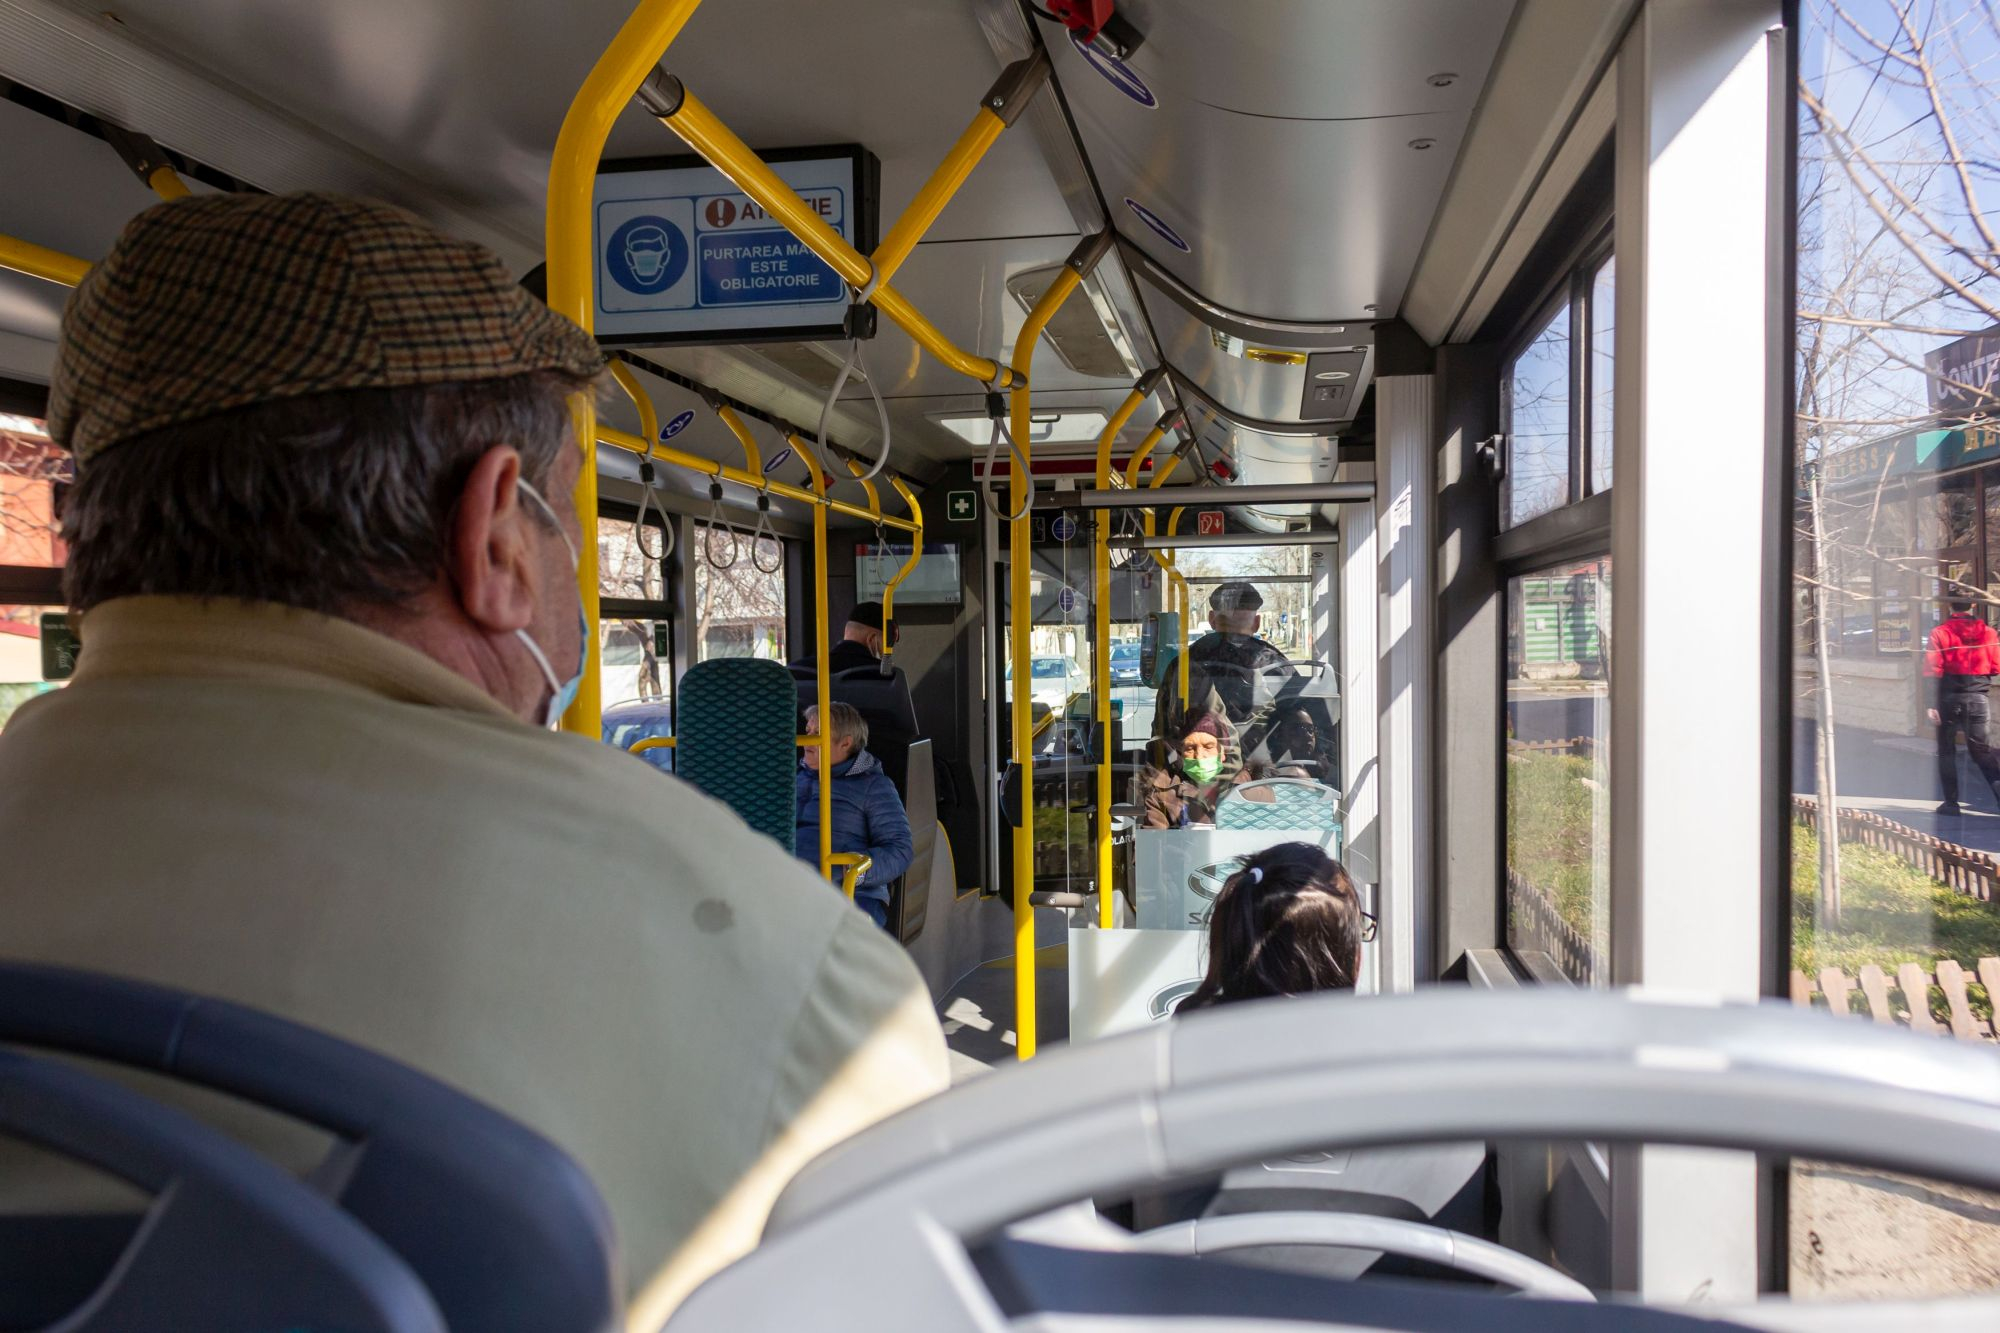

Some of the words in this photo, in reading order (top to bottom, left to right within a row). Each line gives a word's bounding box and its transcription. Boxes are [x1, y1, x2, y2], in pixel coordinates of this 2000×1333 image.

[703, 245, 783, 260] PURTAREA
[750, 260, 789, 273] ESTE
[720, 273, 820, 290] OBLIGATORIE
